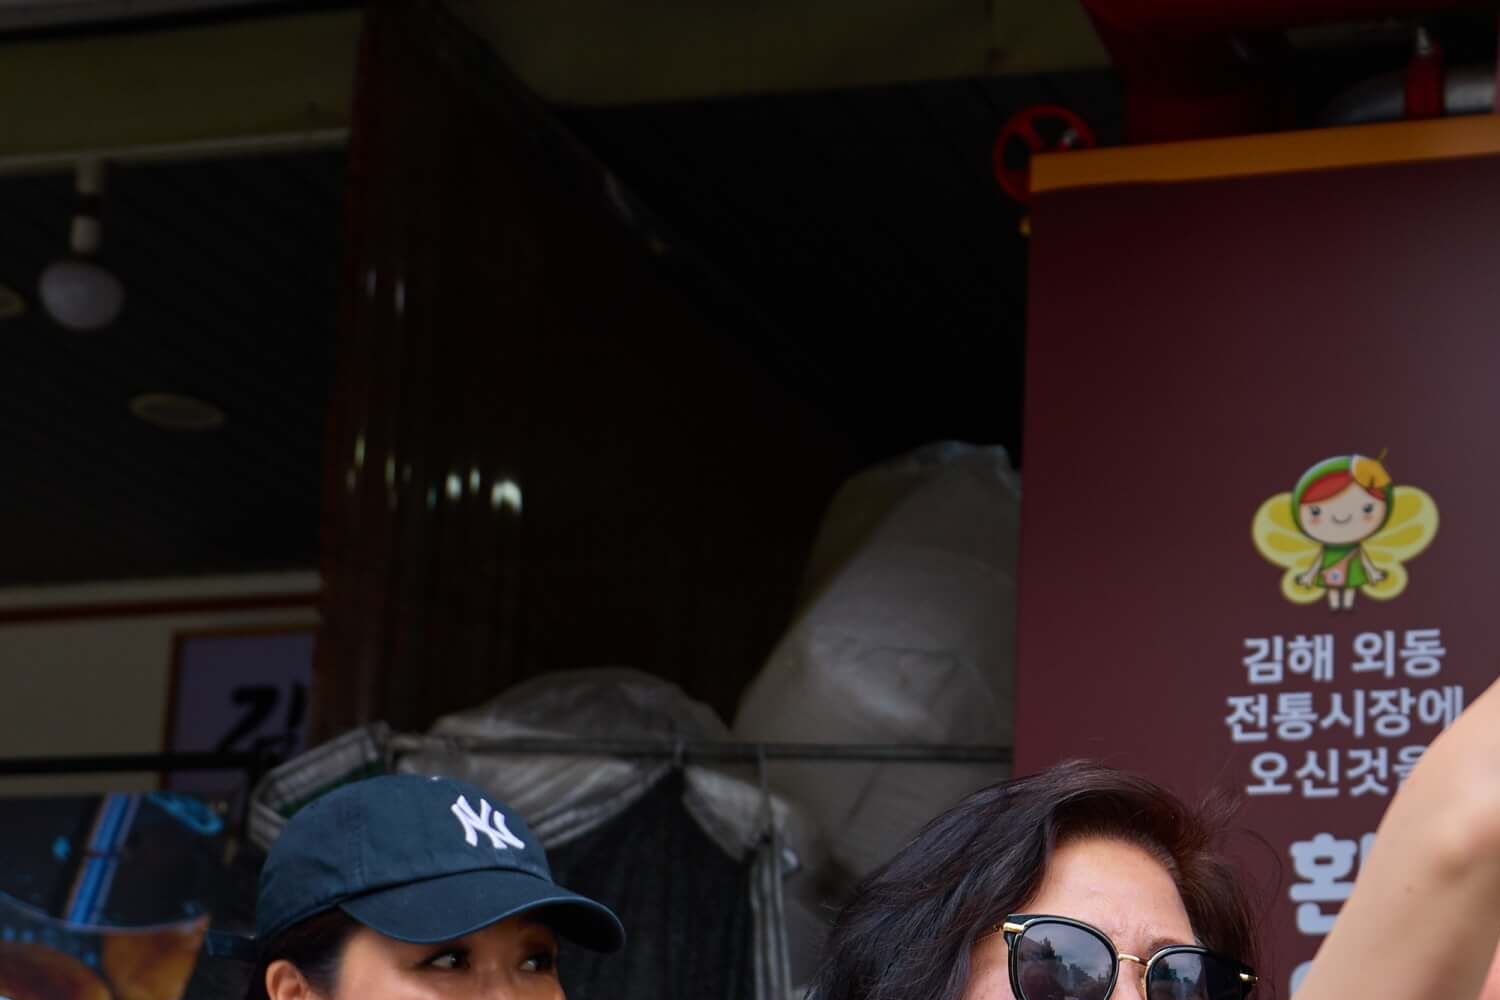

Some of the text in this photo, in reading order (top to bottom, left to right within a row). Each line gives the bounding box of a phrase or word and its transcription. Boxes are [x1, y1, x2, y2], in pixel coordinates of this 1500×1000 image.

[1242, 628, 1447, 684] 김해 외동
[1225, 686, 1464, 742] 전통시장에
[451, 795, 525, 849] NY
